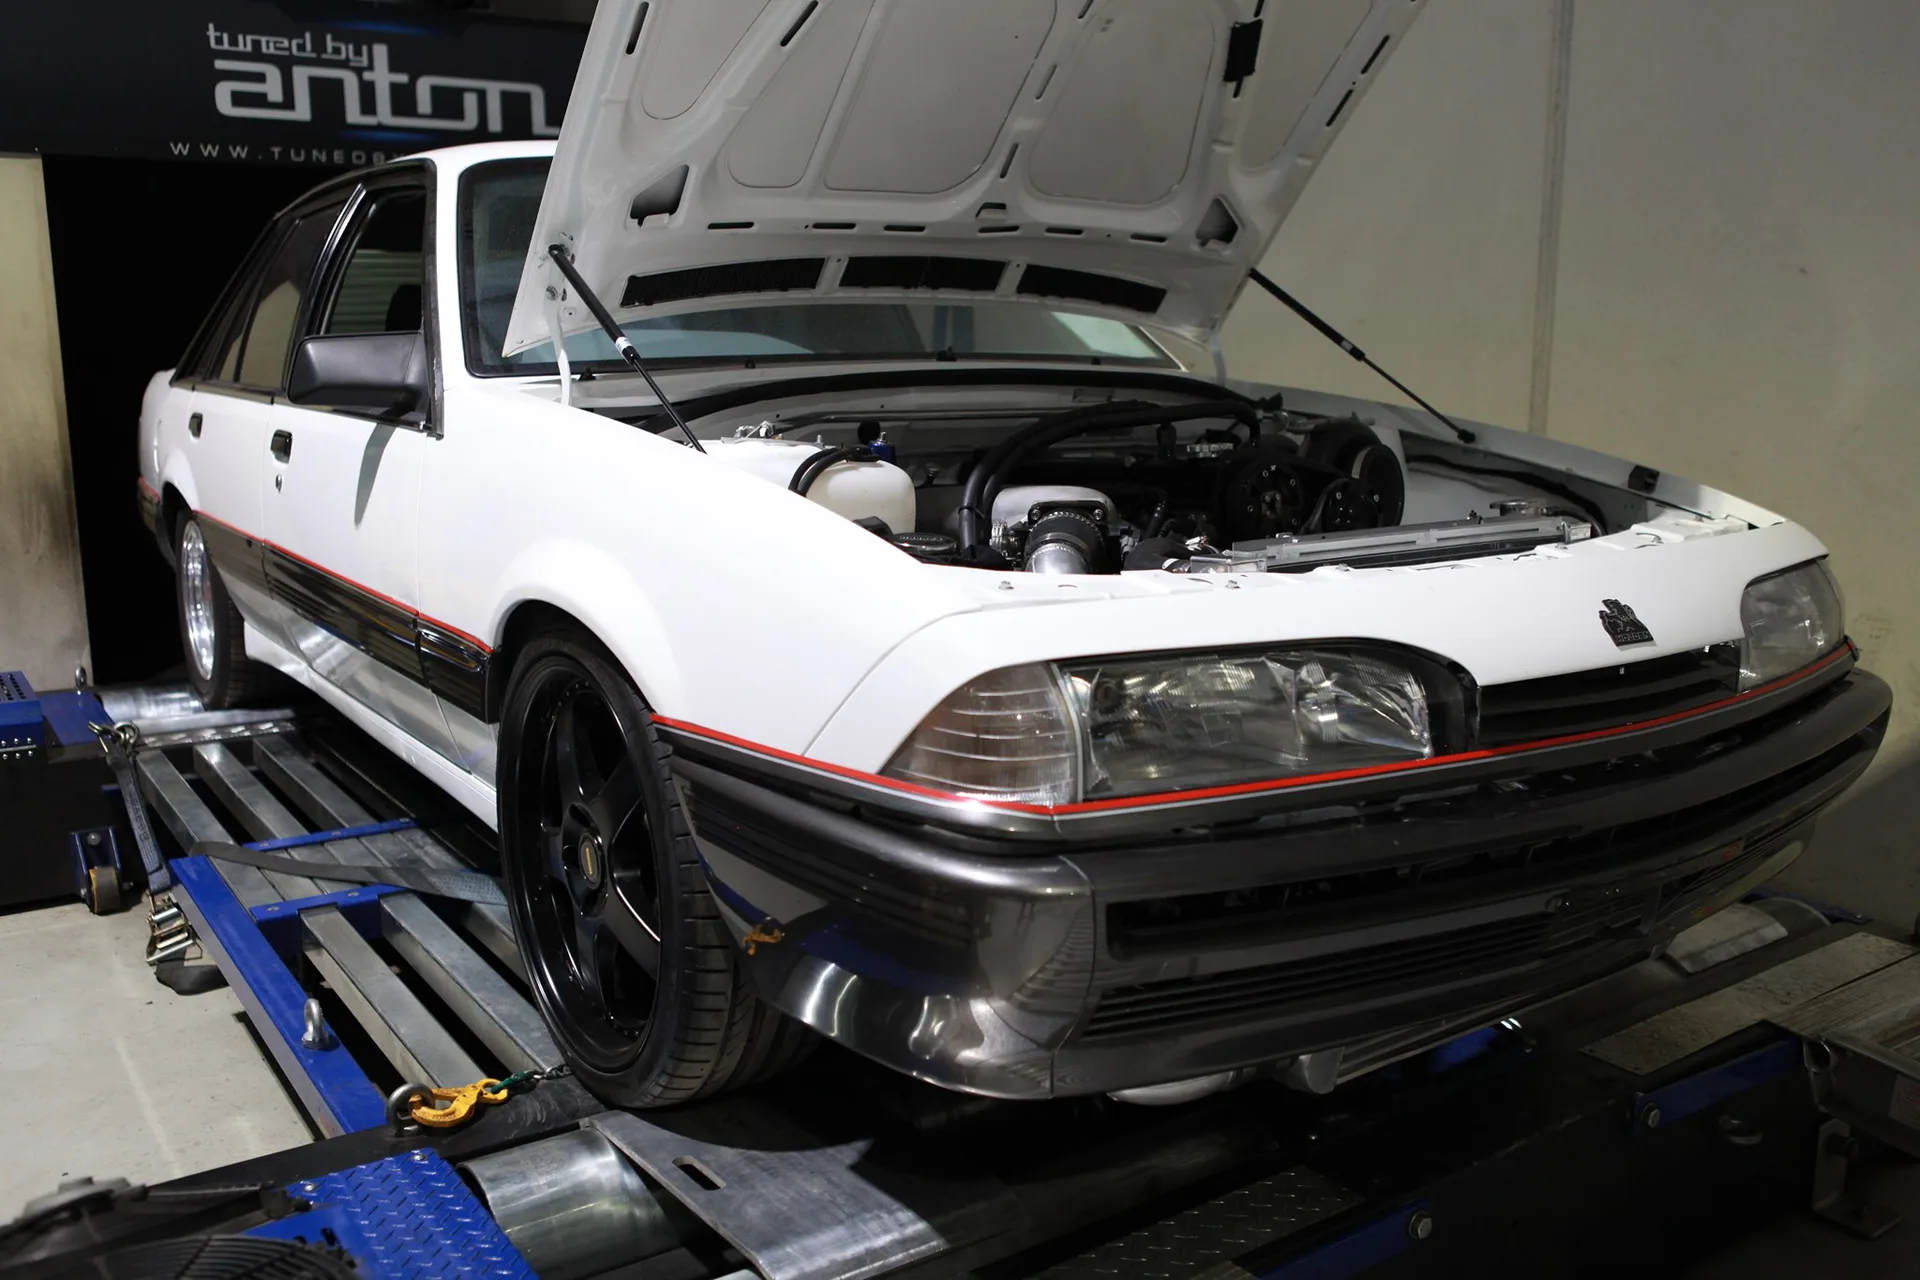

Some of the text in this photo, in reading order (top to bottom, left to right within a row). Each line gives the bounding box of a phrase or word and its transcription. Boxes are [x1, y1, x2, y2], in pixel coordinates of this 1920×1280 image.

[206, 22, 368, 67] tuned by
[214, 43, 560, 136] anton
